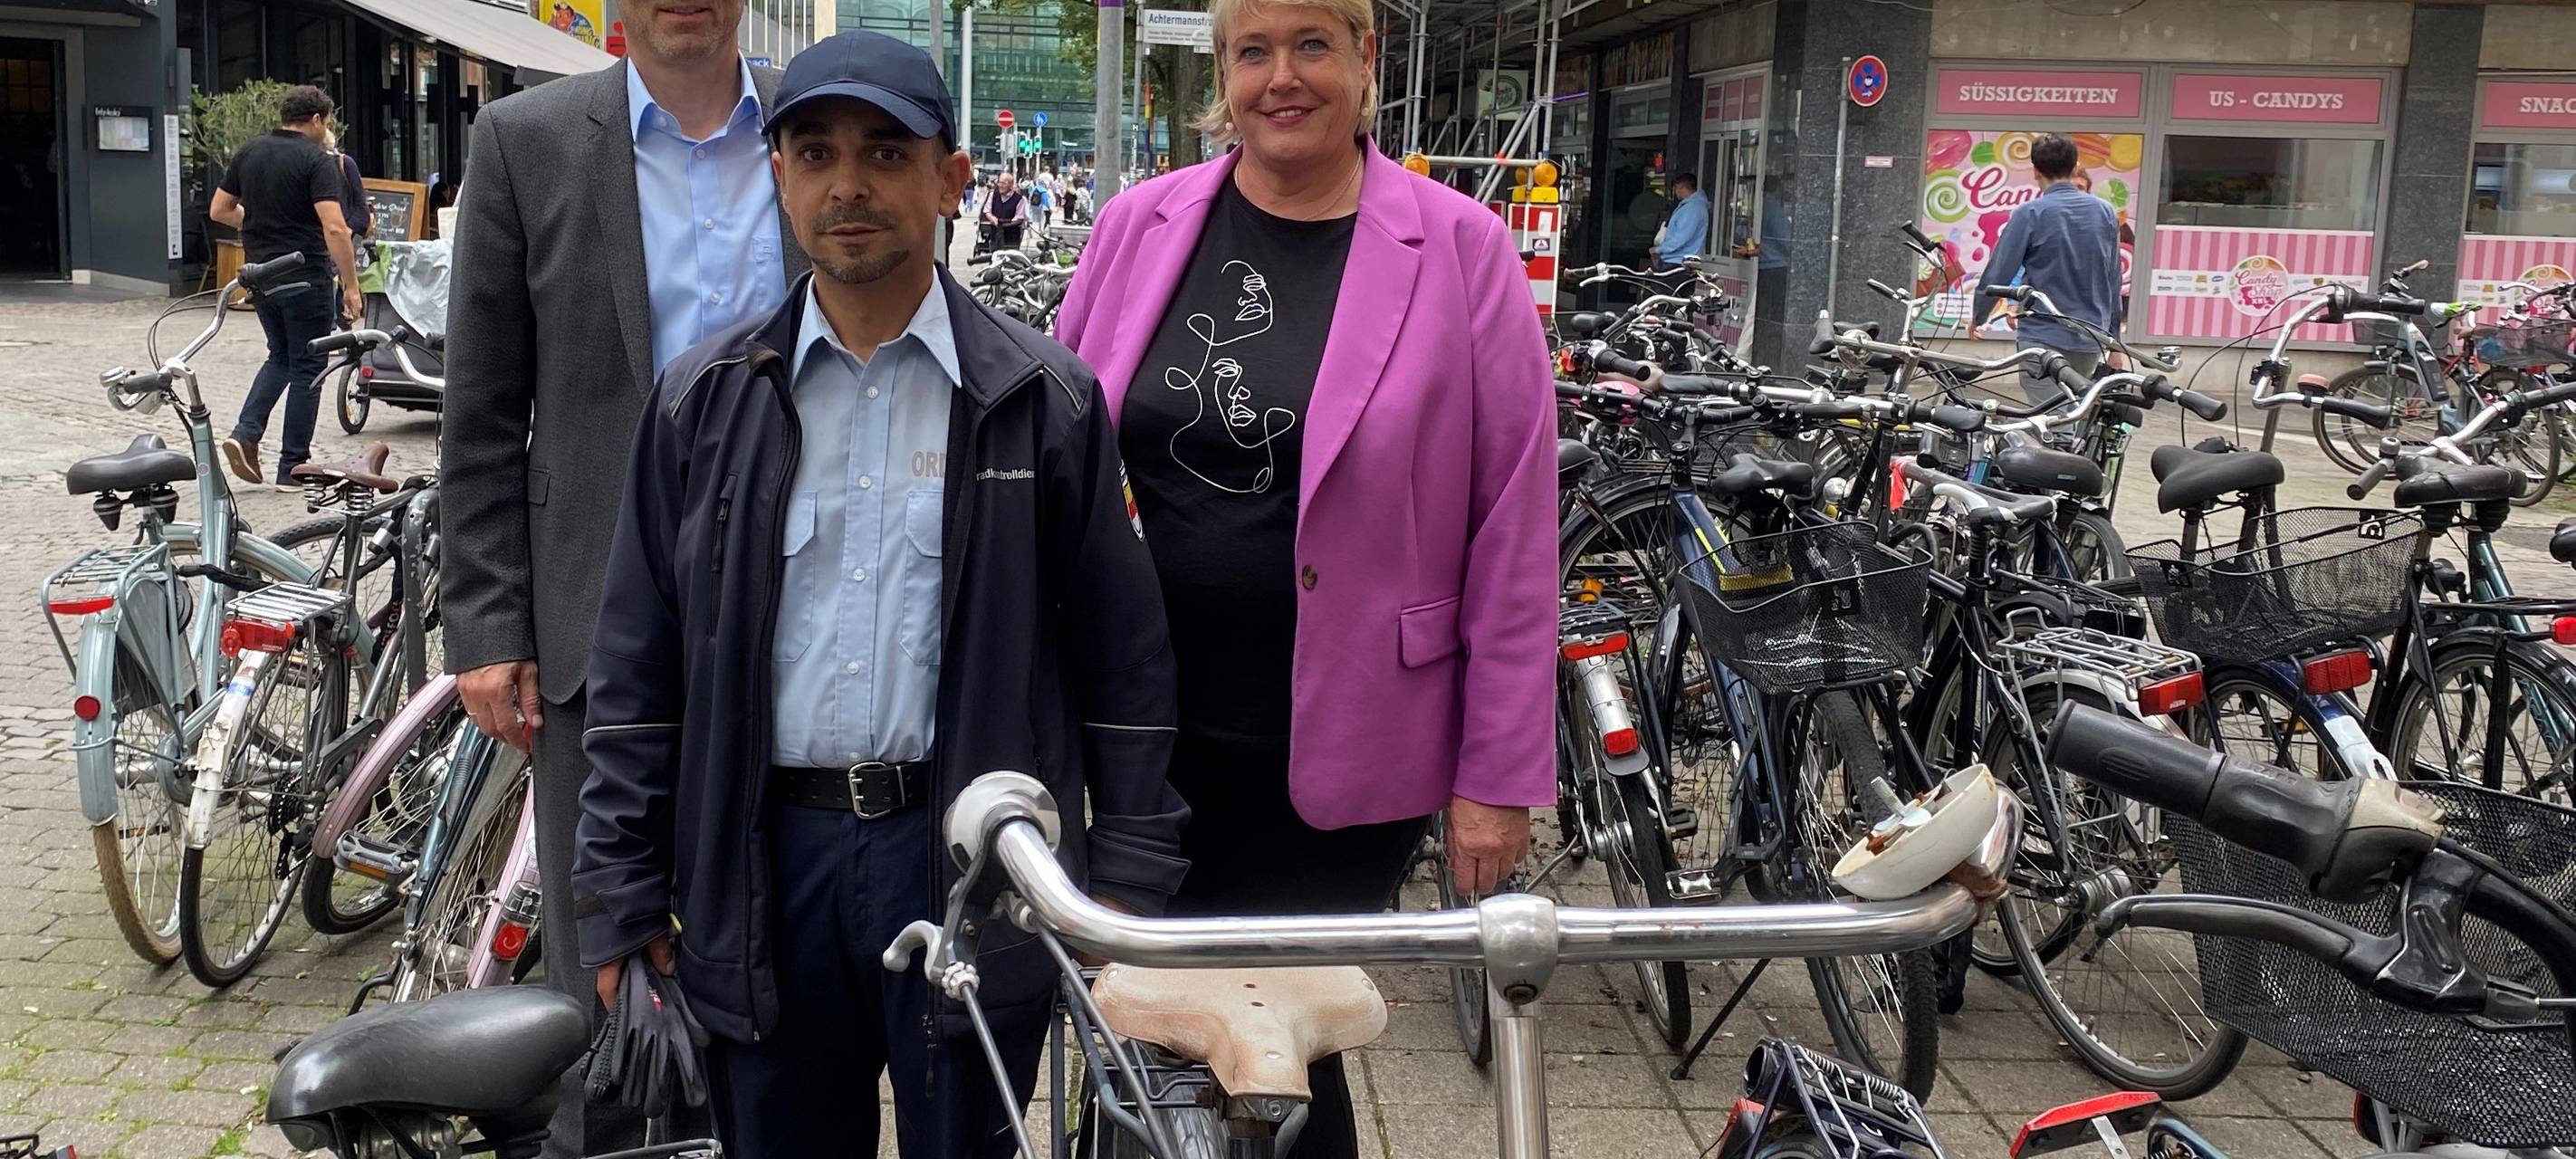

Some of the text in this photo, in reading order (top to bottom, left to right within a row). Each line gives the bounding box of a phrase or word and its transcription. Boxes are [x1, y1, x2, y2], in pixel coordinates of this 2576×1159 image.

[1959, 82, 2118, 103] SÜSSIGKEITEN
[2209, 91, 2234, 107] US
[2253, 92, 2343, 109] CANDYS
[1961, 167, 2044, 209] Can
[2235, 270, 2283, 288] Candy
